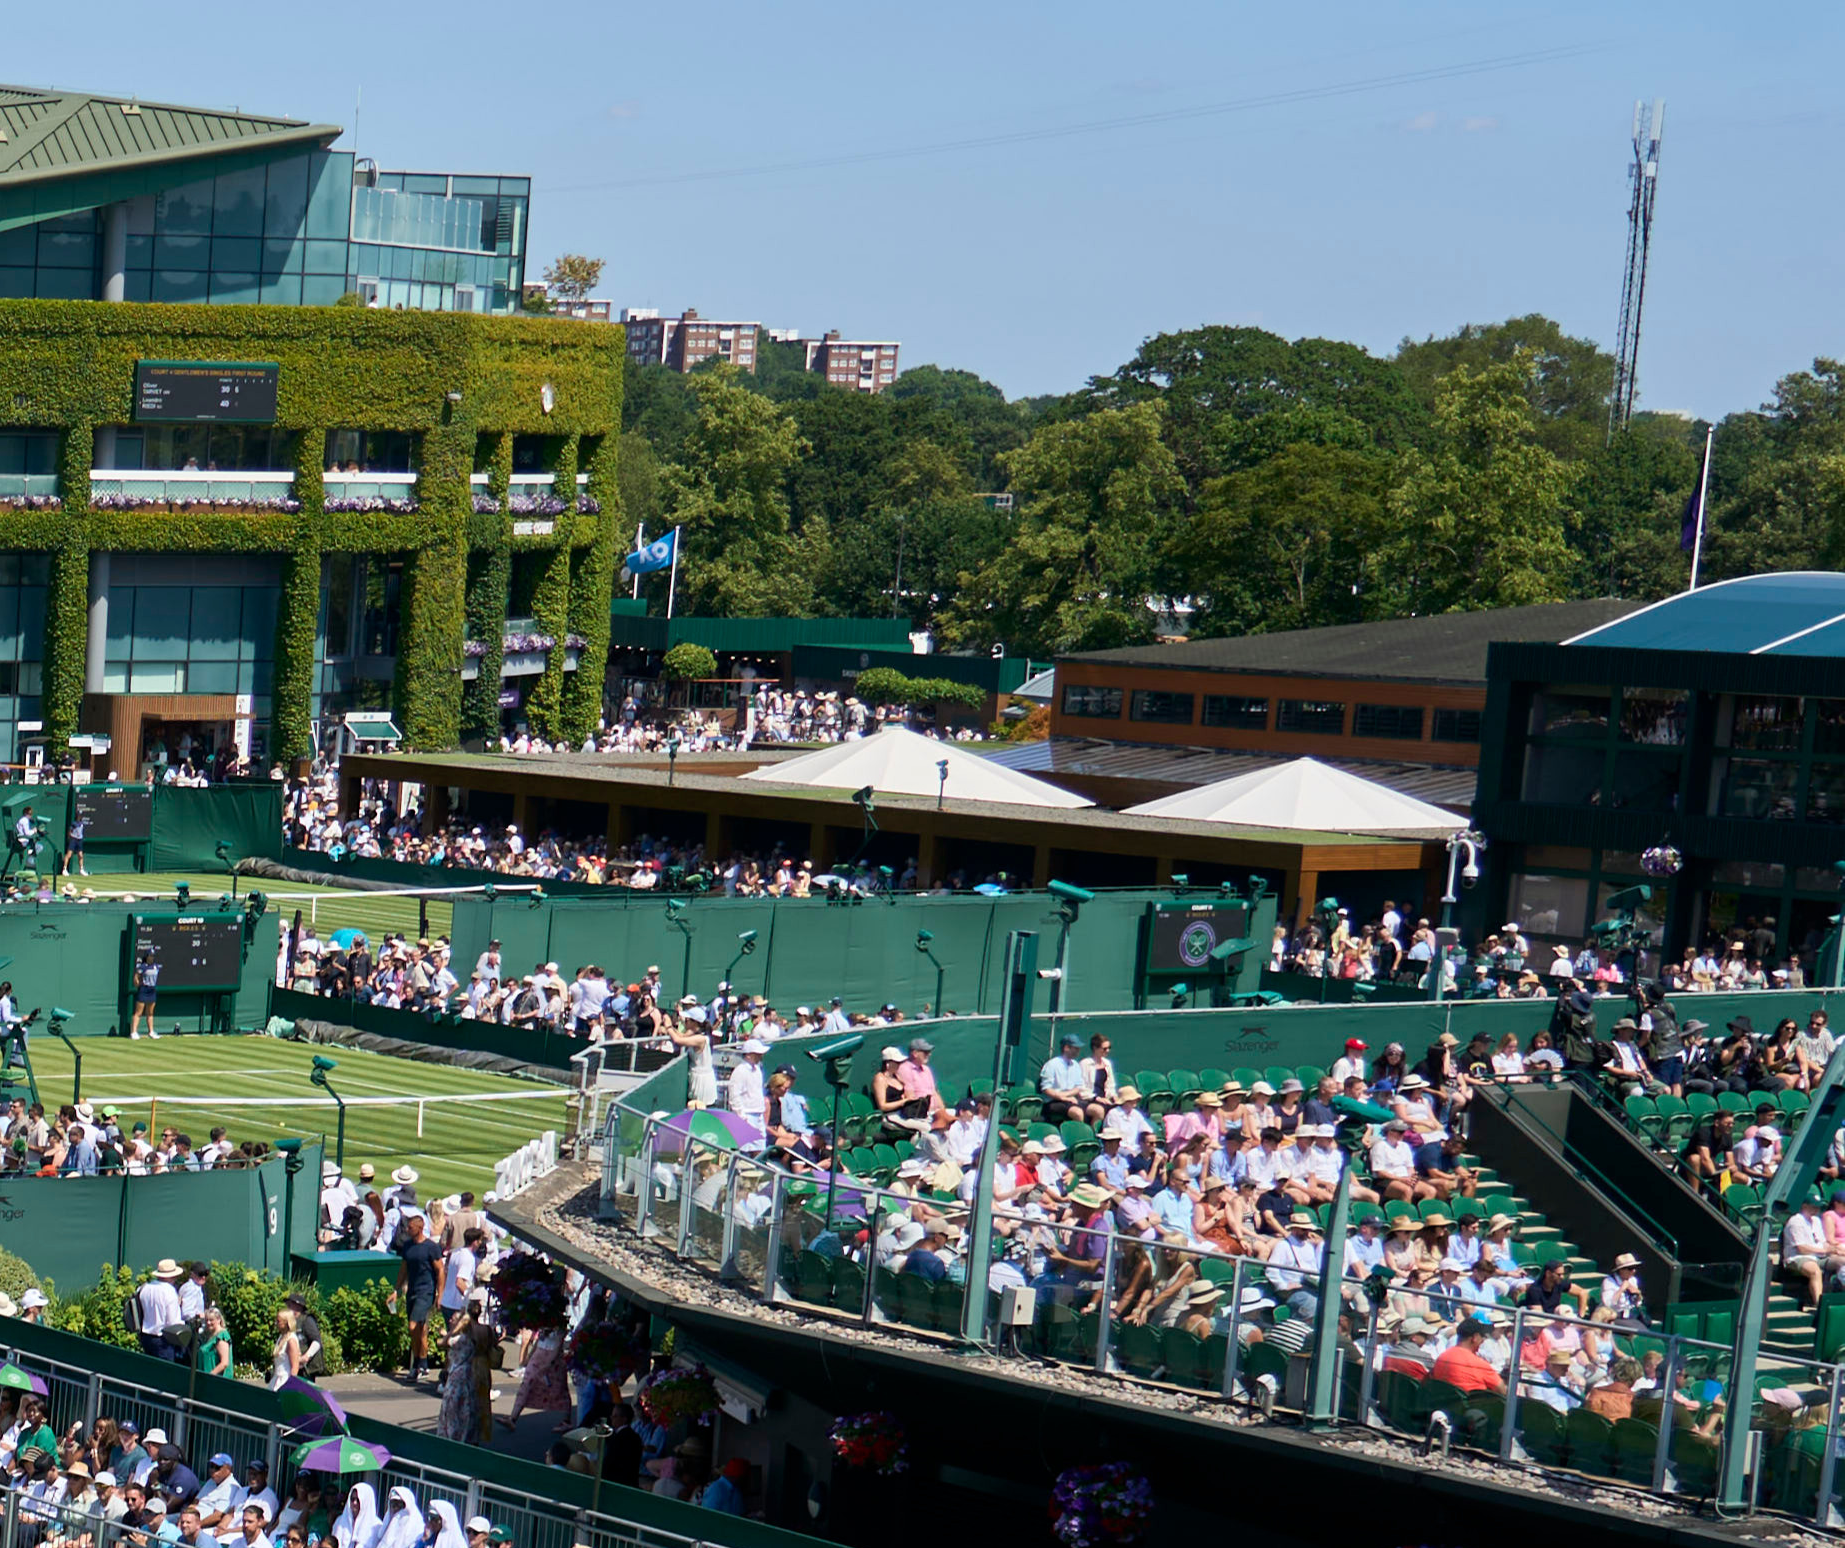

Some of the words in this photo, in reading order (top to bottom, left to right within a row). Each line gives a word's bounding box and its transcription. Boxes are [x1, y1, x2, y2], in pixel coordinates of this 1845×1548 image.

[221, 385, 230, 393] 30
[220, 400, 229, 408] 40
[1224, 1039, 1280, 1054] Slazenger
[269, 1208, 277, 1235] 9
